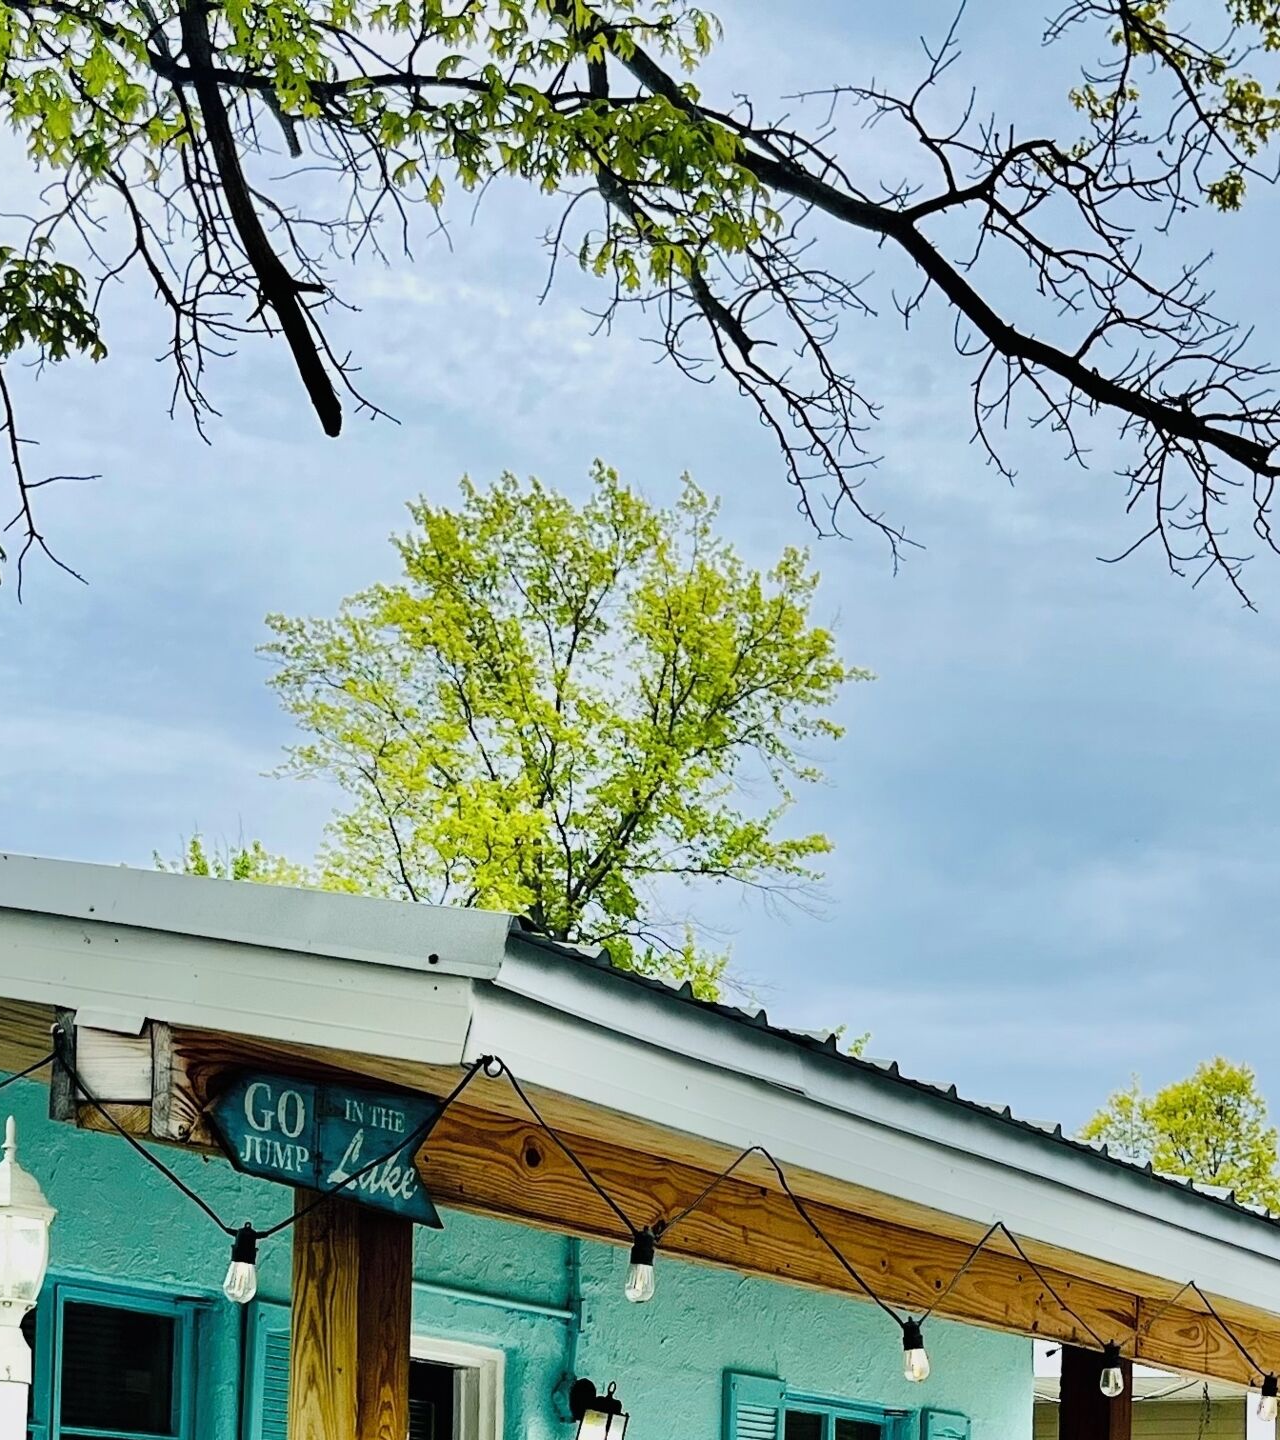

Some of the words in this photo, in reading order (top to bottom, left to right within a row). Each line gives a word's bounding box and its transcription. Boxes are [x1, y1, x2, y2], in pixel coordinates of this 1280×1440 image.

[244, 1082, 306, 1138] GO
[344, 1099, 364, 1124] IN
[371, 1105, 405, 1134] THE
[240, 1134, 310, 1173] JUMP
[327, 1128, 418, 1200] Lake
